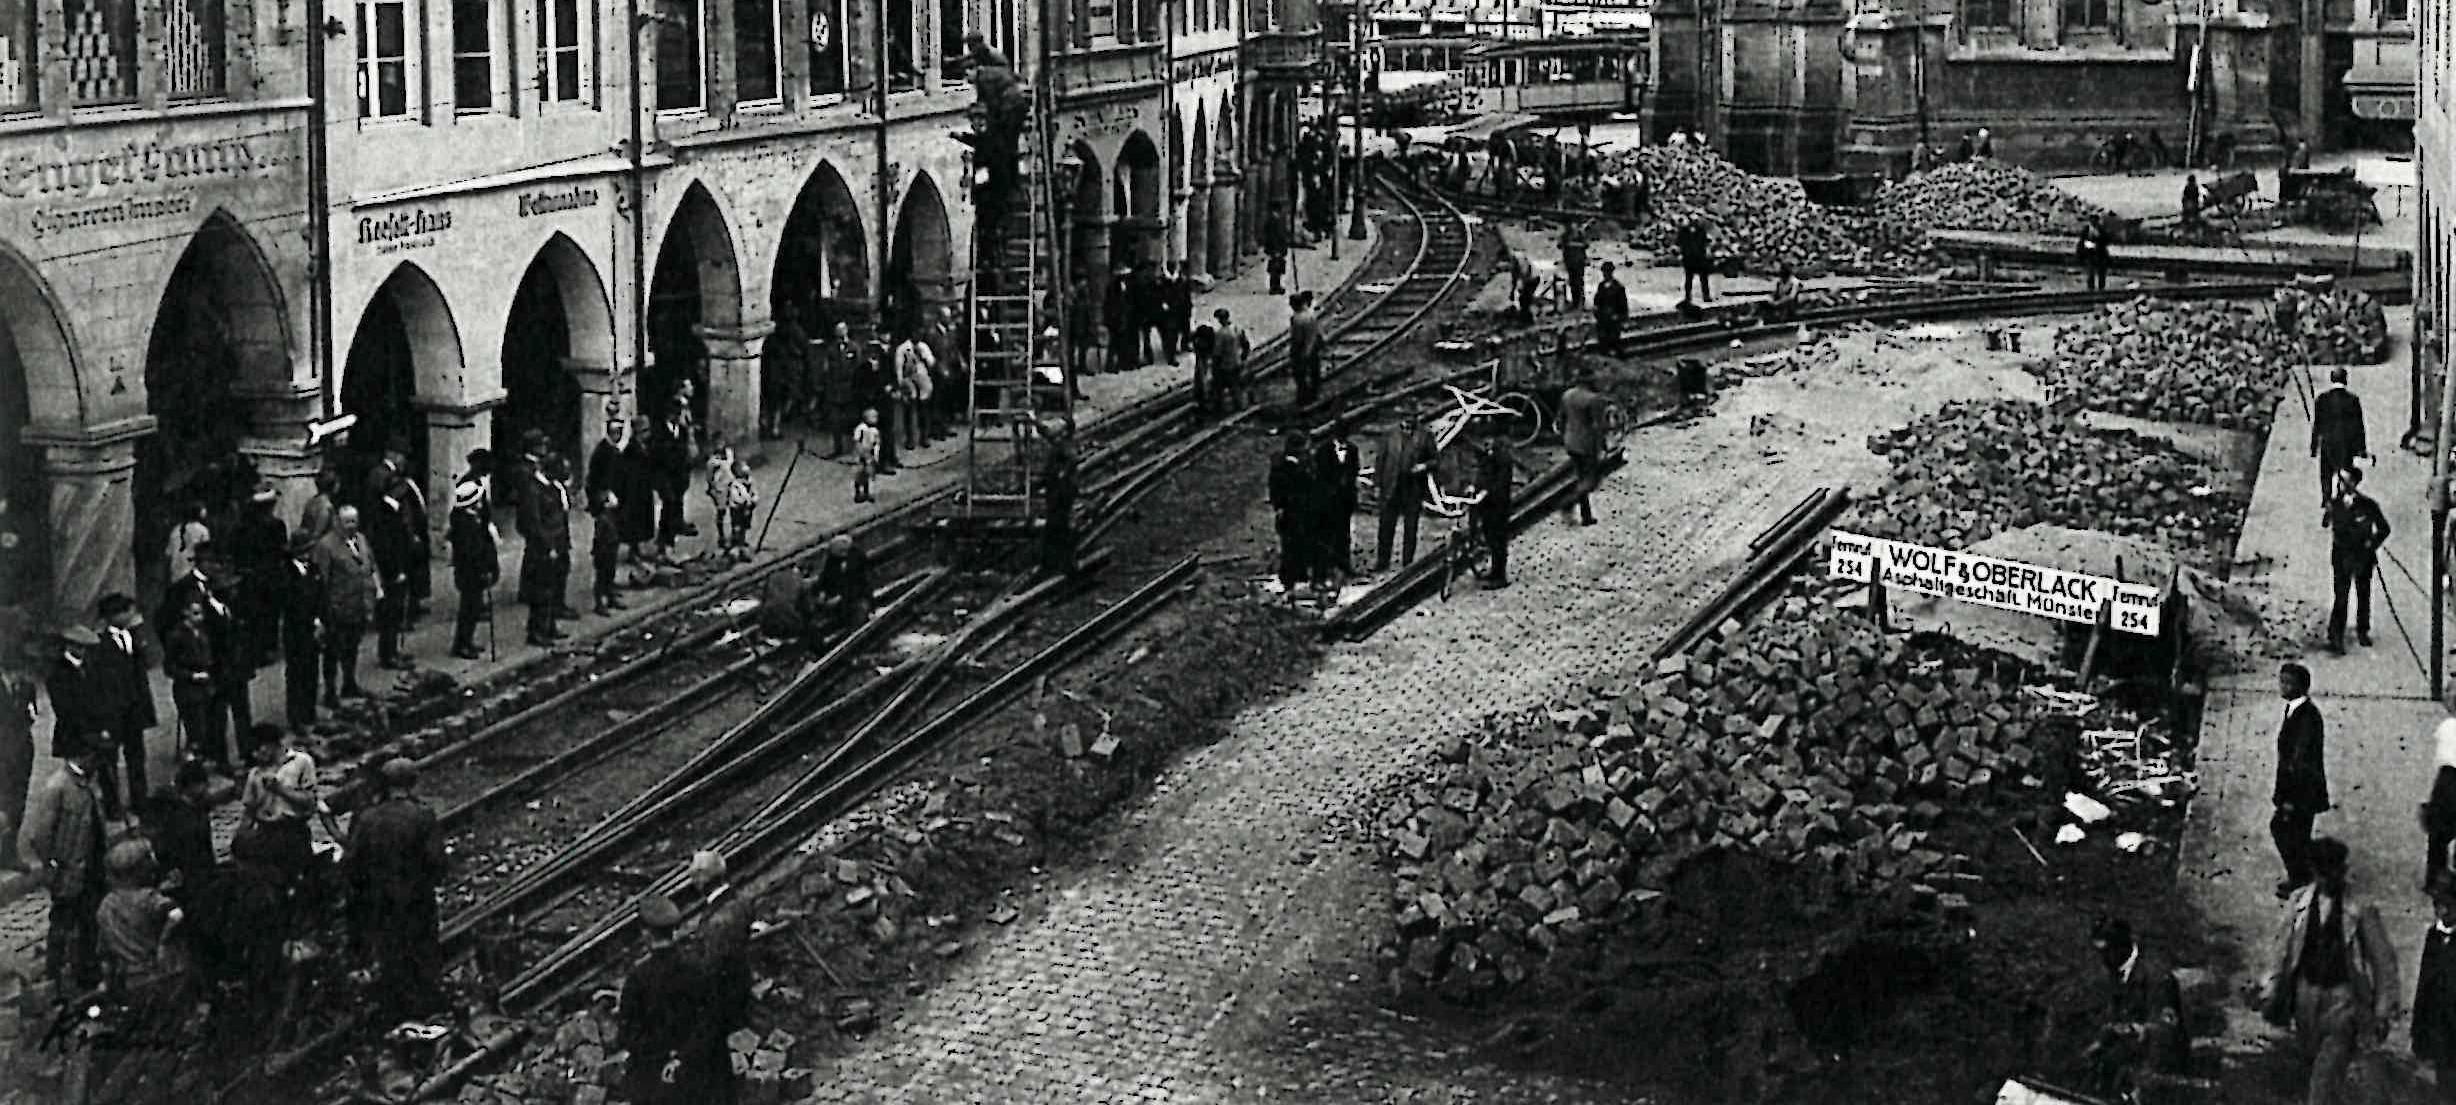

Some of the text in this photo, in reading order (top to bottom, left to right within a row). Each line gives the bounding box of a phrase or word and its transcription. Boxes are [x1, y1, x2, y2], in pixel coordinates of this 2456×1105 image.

[1837, 558, 1862, 577] 254
[1888, 544, 1957, 577] WOLF
[1972, 561, 2097, 603] OBERLACK
[2121, 610, 2148, 630] 254
